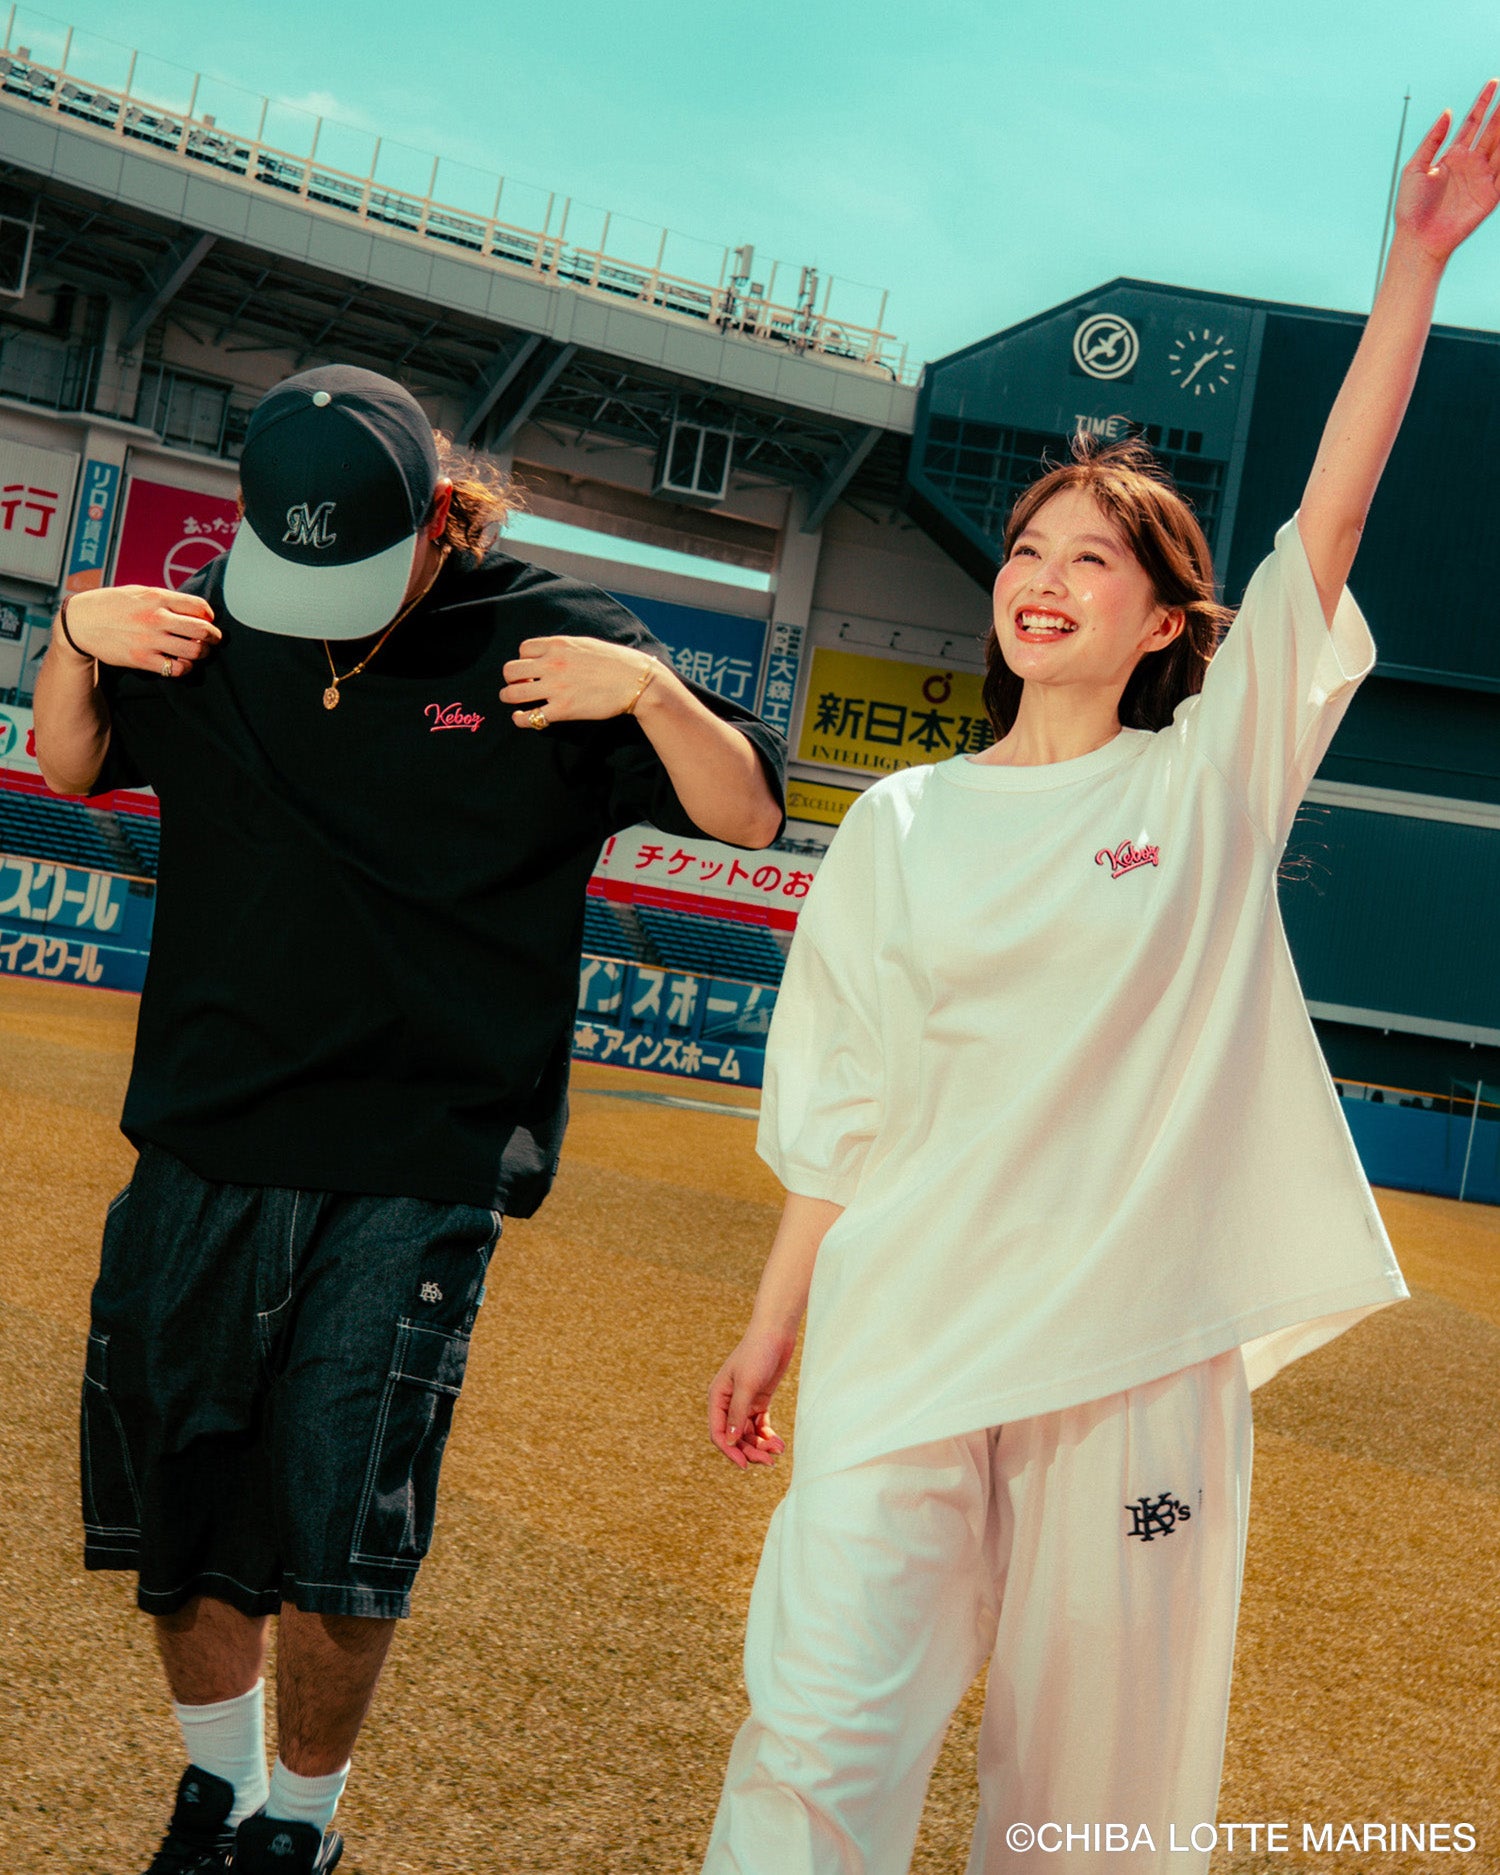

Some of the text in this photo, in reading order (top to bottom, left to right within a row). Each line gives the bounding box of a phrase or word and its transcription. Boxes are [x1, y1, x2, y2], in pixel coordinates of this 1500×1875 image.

[1074, 414, 1119, 438] TIME
[1, 485, 58, 537] 行
[282, 502, 337, 549] M
[666, 645, 753, 698] 銀行
[0, 857, 120, 931] スクール
[635, 845, 814, 898] チケットのお
[0, 932, 104, 983] イスクール
[600, 1028, 741, 1081] アインスホーム
